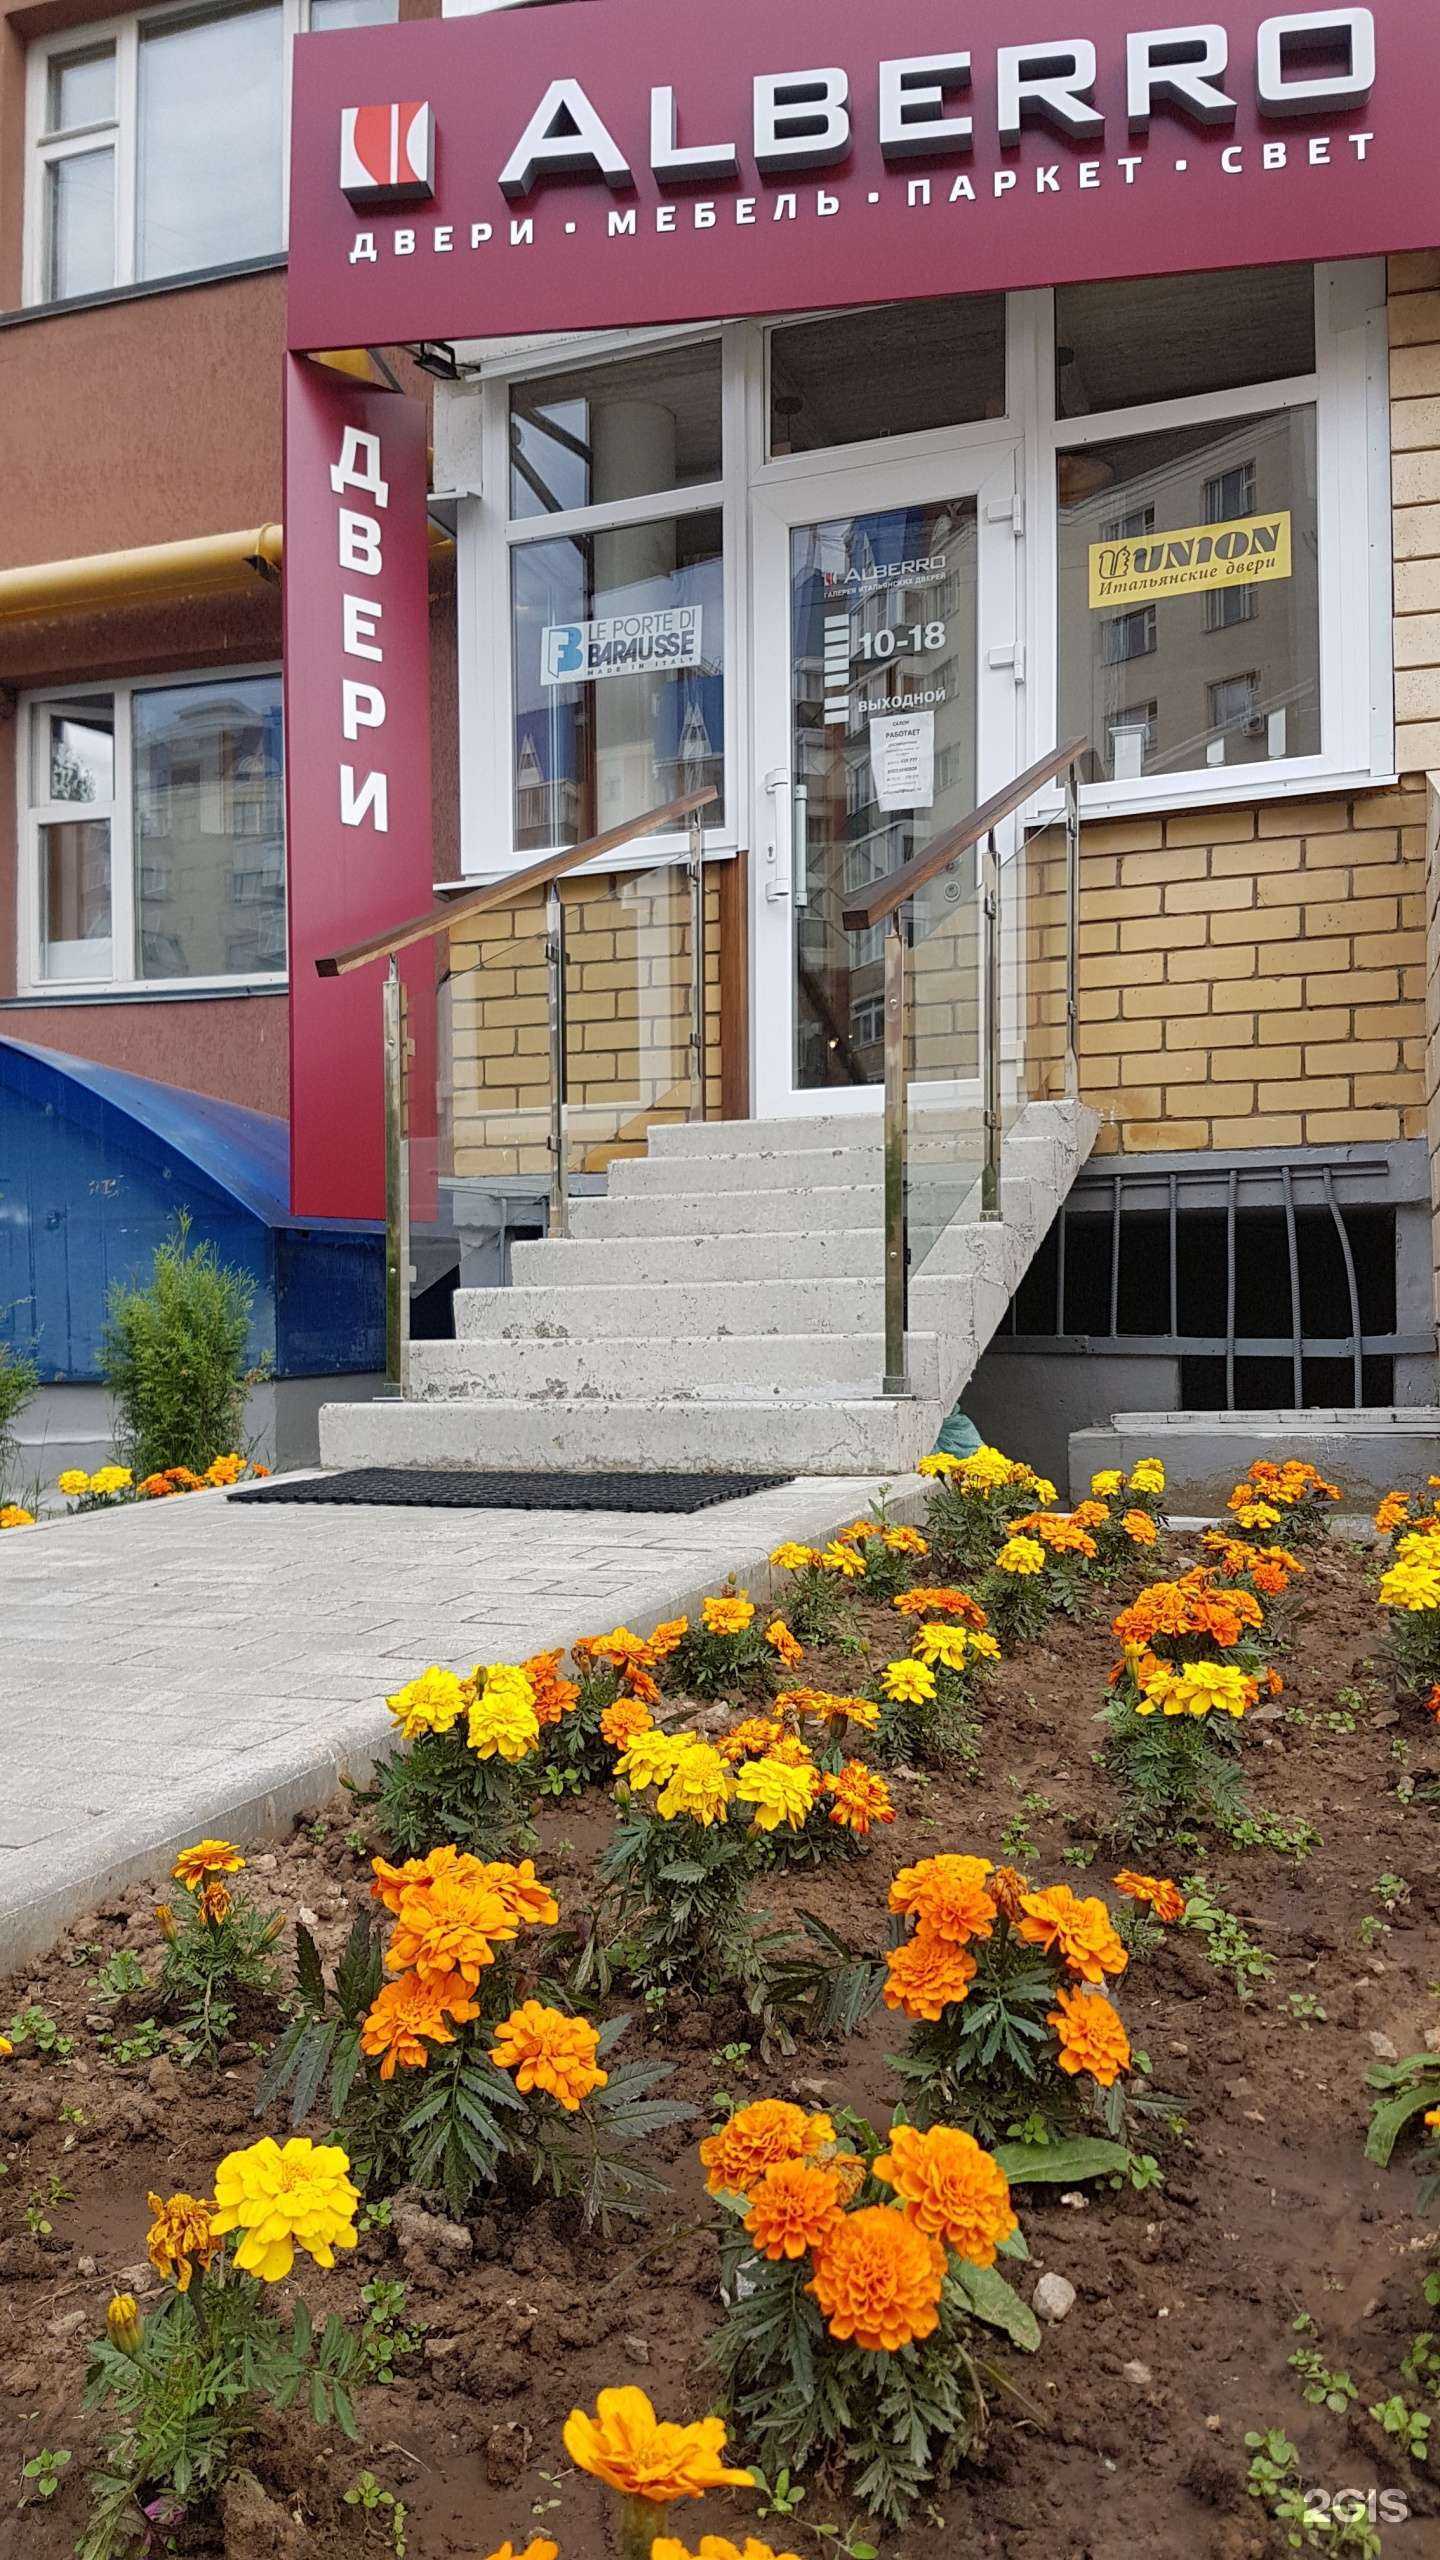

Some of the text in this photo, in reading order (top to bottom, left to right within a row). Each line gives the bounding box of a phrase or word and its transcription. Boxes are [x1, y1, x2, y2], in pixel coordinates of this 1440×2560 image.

[498, 6, 1376, 186] ALBERRO
[348, 132, 1374, 264] ДВЕРИ МЕБЕЛЬ ПАРКЕТ СВЕТ
[1132, 522, 1281, 573] UNION
[844, 555, 946, 584] ALBERRO
[1098, 557, 1276, 596] Итальянские двери
[329, 425, 390, 834] ДВЕРИ
[588, 608, 696, 642] LE PORTE DI
[858, 620, 947, 660] 10-18
[587, 665, 621, 676] MADE
[655, 657, 694, 667] ITALY
[588, 630, 694, 668] BARAUSSE
[858, 687, 946, 713] ВЫХОДНОЙ
[886, 728, 920, 739] РАБОТАЕТ
